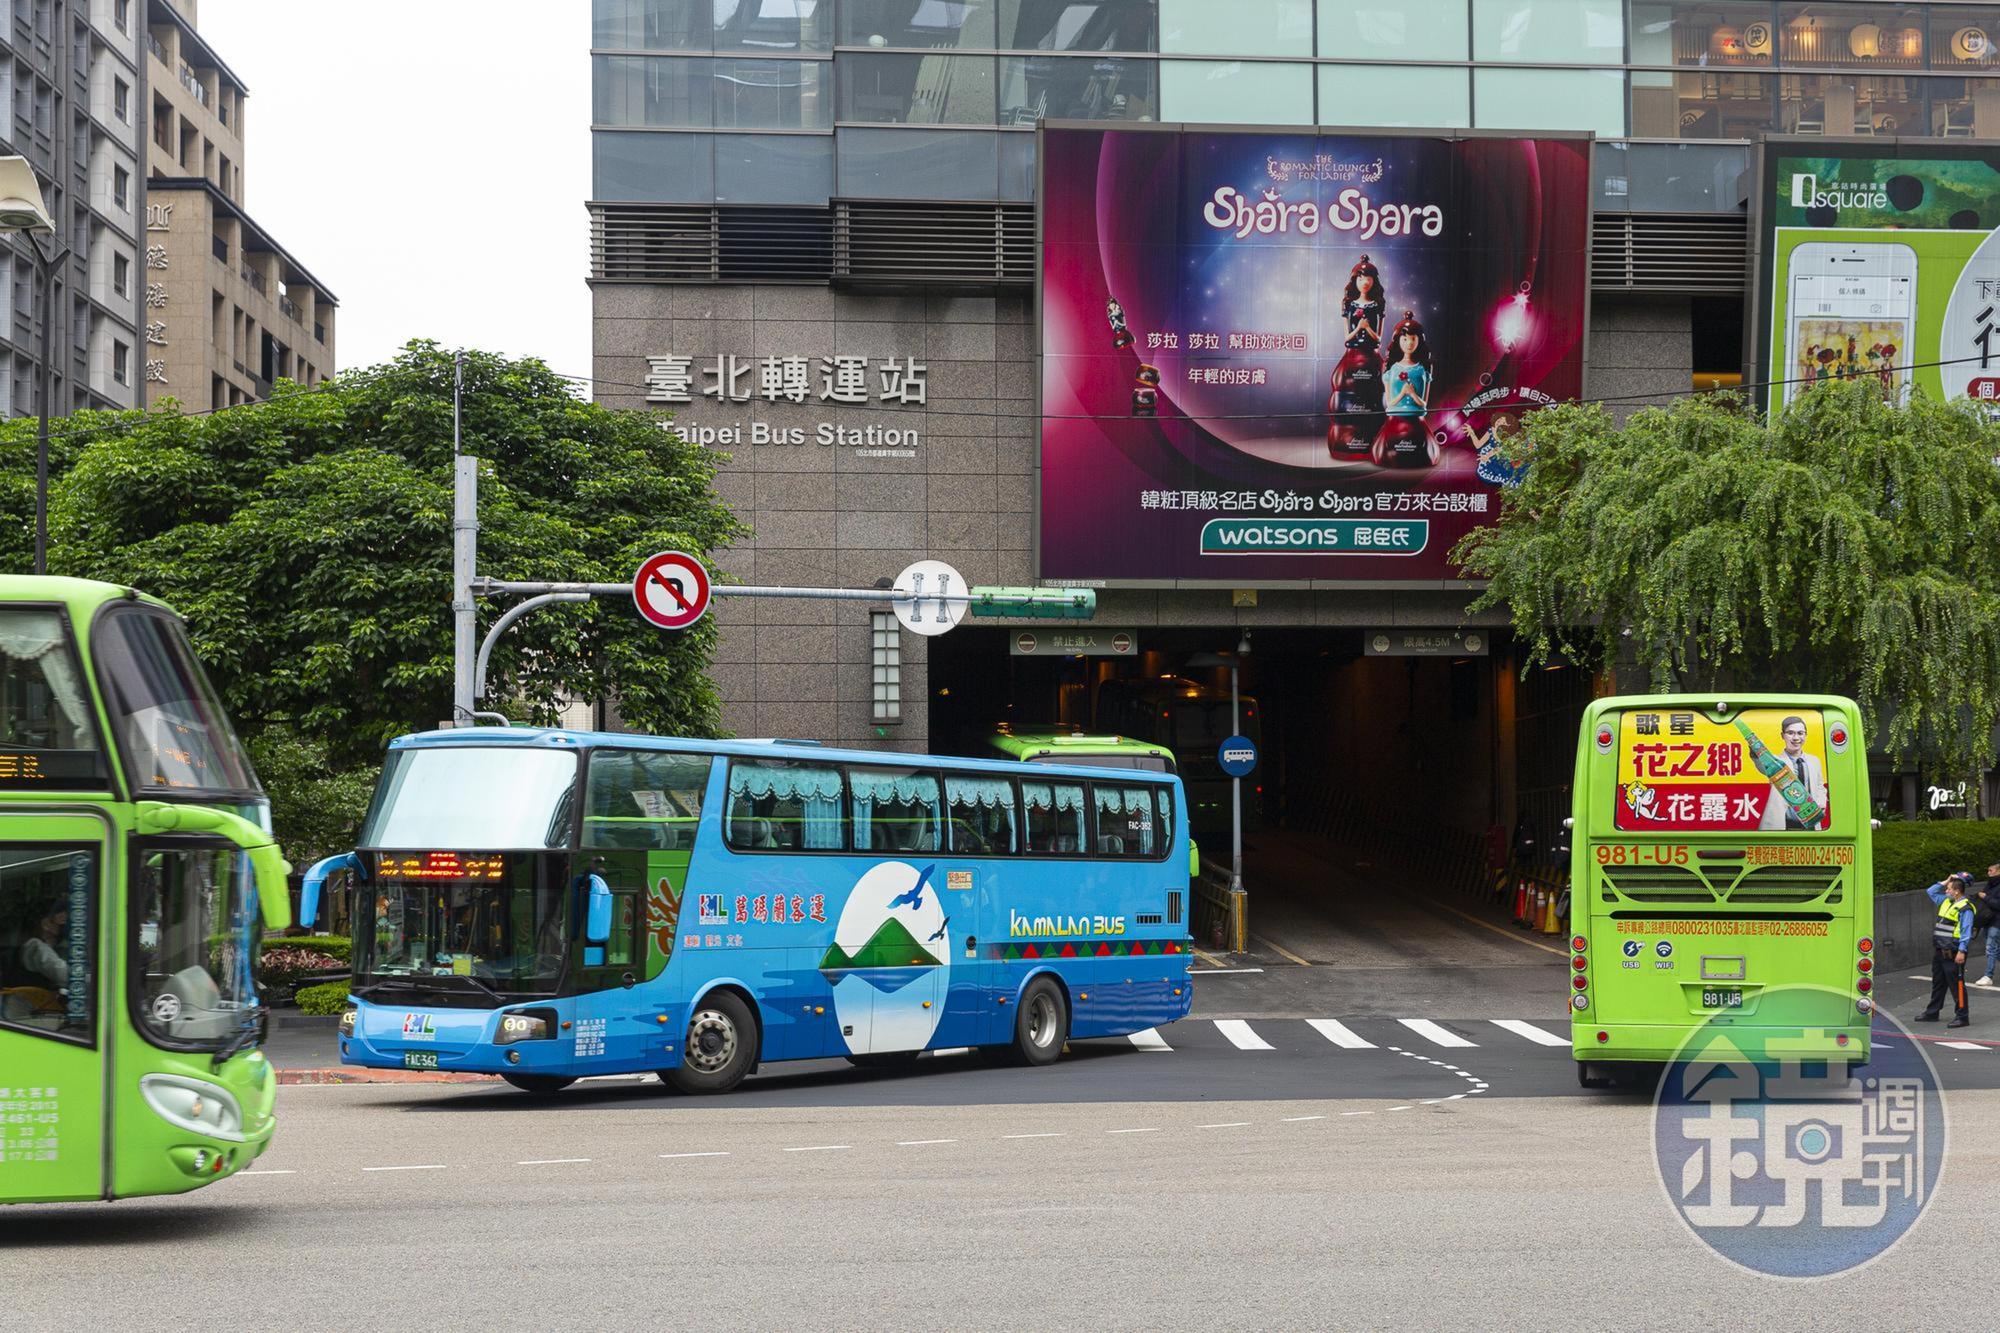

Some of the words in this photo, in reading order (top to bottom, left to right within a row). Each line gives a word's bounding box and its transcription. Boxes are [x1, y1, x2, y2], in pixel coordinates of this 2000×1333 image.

[1280, 162, 1331, 172] ROMANTIC
[1333, 164, 1370, 172] LOUNGE
[1315, 155, 1332, 163] THE
[1299, 172, 1318, 180] FOR
[1321, 172, 1352, 180] LADIES
[1203, 187, 1319, 239] Shara
[1328, 188, 1443, 241] Shara
[1974, 279, 2000, 300] 下
[1147, 333, 1178, 349] 莎拉
[1189, 333, 1219, 349] 莎拉
[1229, 334, 1307, 350] 幫助妳找回
[644, 353, 927, 404] 臺北轉運站
[1188, 368, 1266, 384] 年輕的皮膚
[751, 422, 806, 446] Bus
[816, 422, 918, 446] Station
[1218, 526, 1338, 545] watsons
[1354, 528, 1410, 545] 屈臣氏
[1053, 636, 1097, 647] 禁止進入
[1636, 714, 1694, 735] 歌星
[1633, 743, 1742, 777] 花之鄉
[1667, 793, 1760, 821] 花露水
[1596, 845, 1689, 865] 981-U5
[700, 895, 728, 917] KML
[735, 894, 827, 923] 葛瑪蘭客運
[1094, 915, 1125, 934] BUS
[403, 1013, 435, 1033] KML
[405, 1053, 437, 1067] FAC-362
